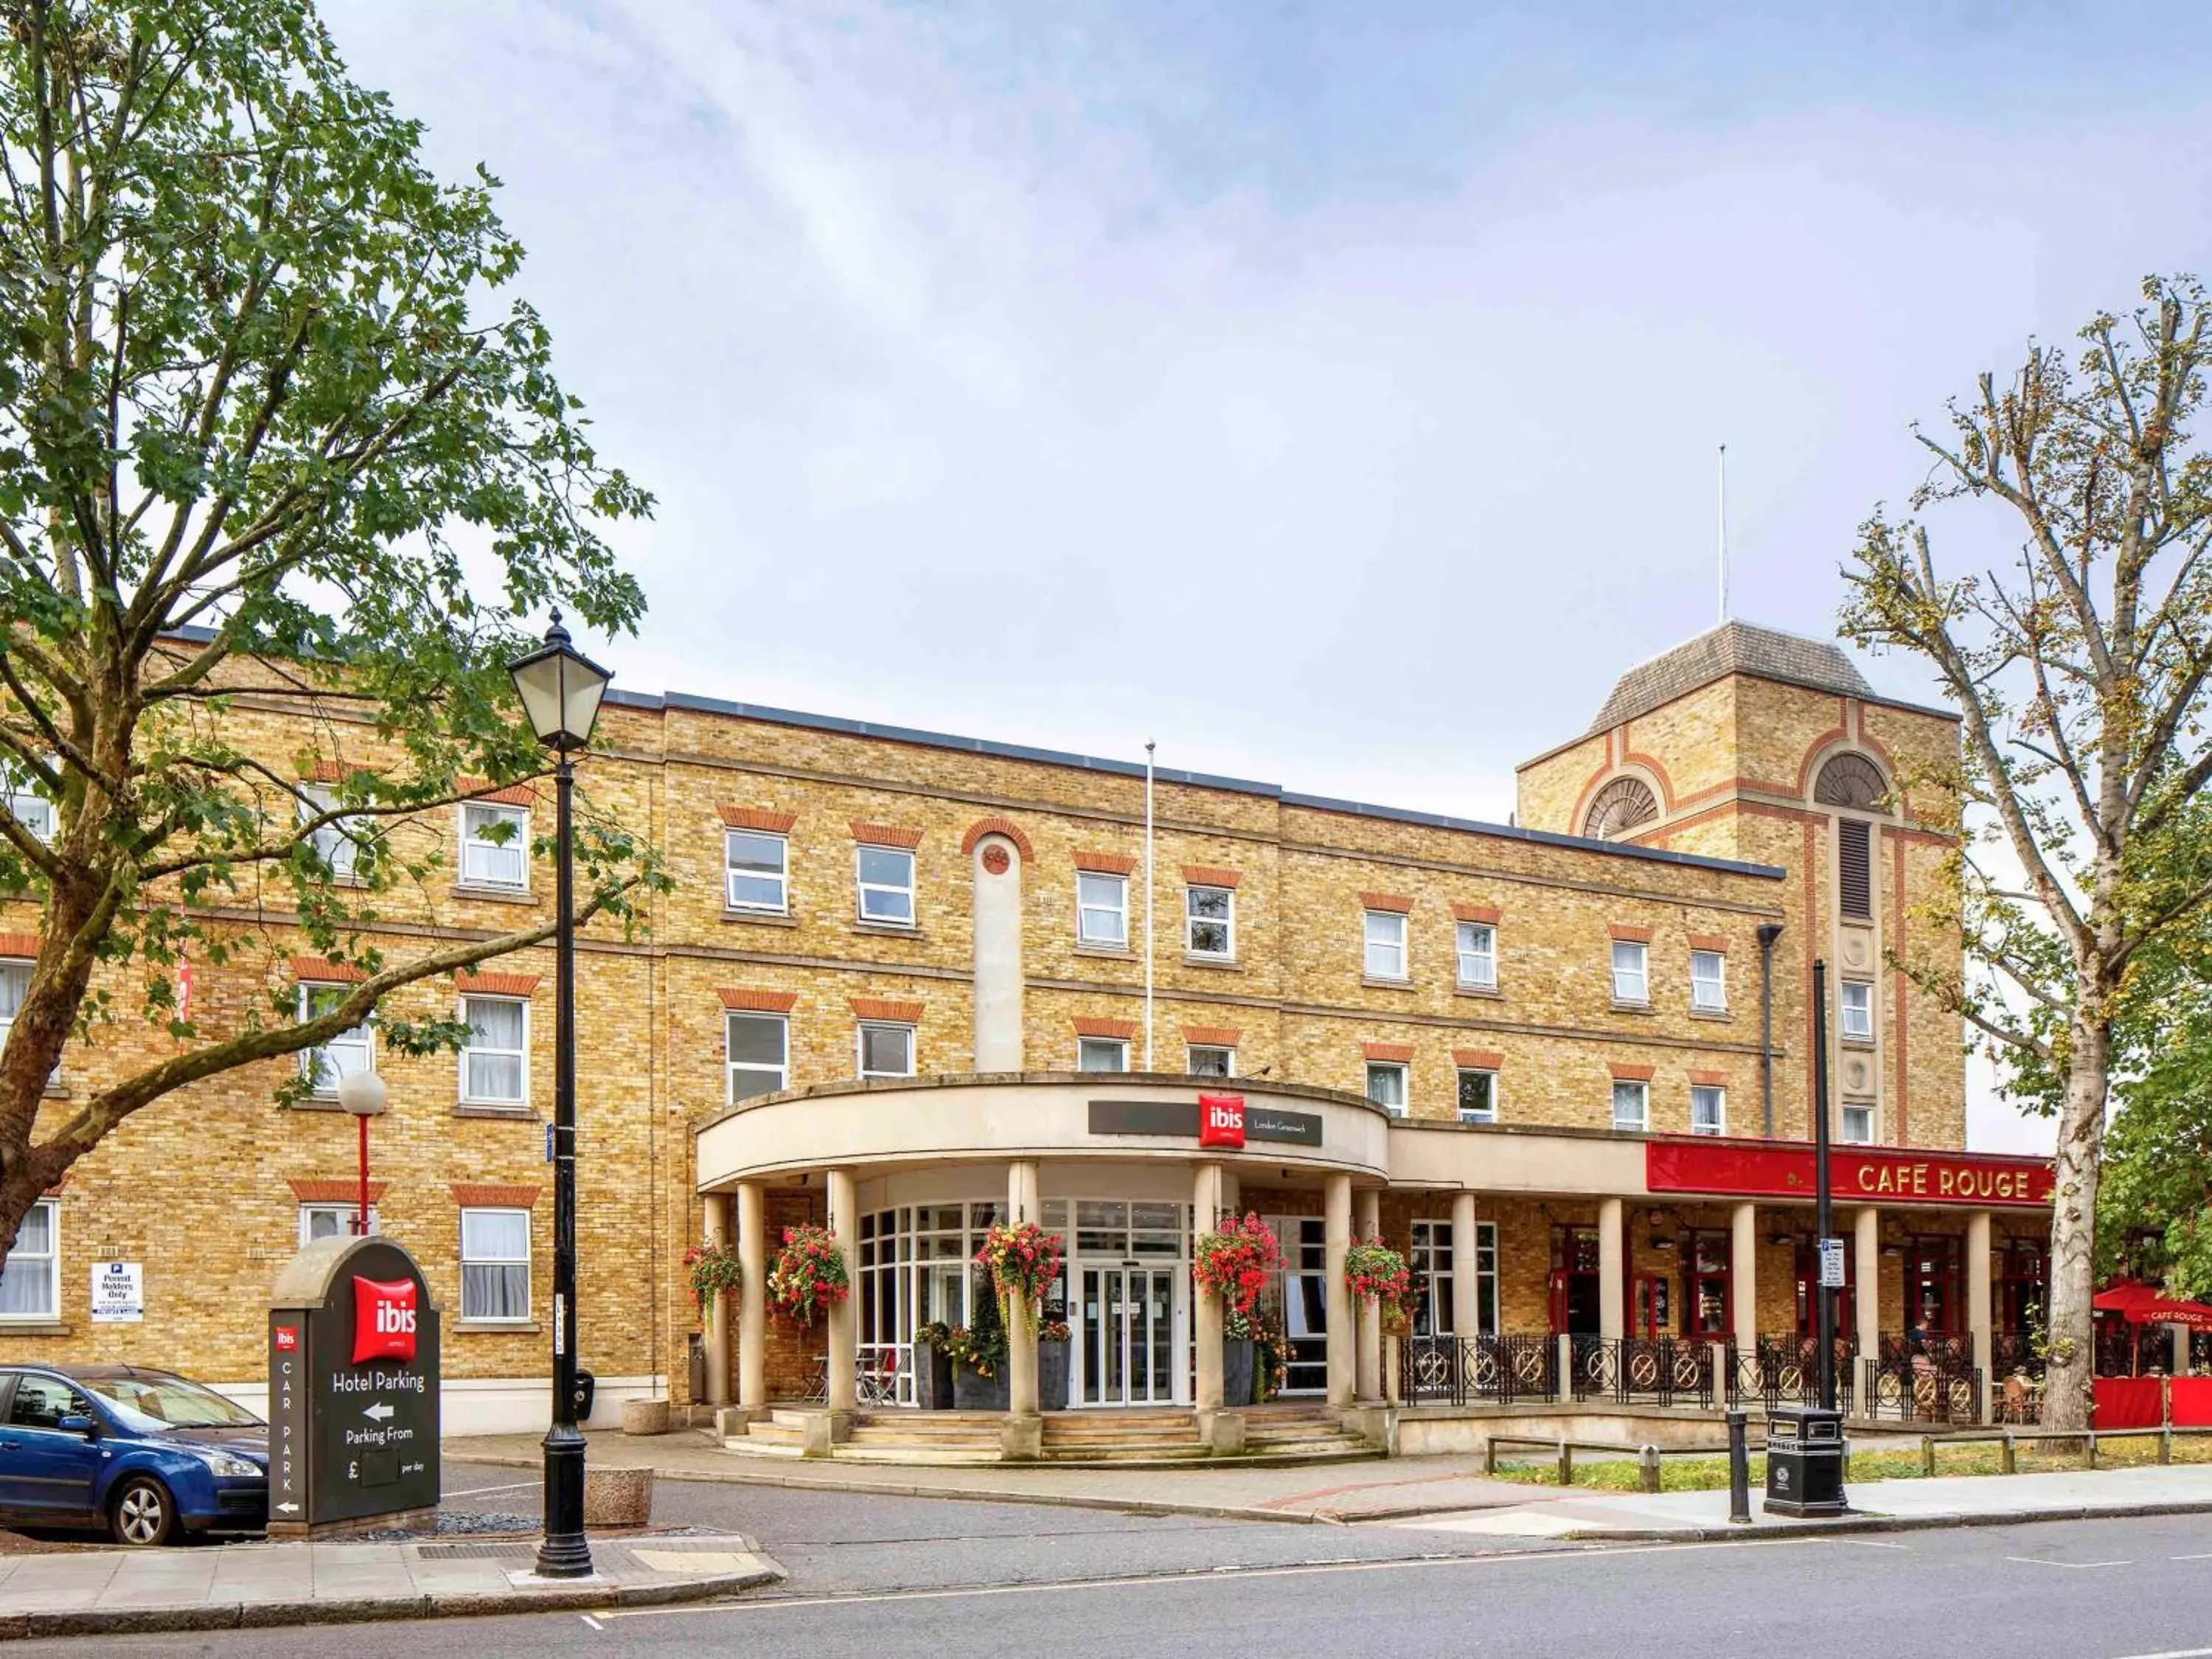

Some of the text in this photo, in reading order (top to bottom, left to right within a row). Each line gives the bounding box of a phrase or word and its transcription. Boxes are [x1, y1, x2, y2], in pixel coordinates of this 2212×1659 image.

[1210, 1107, 1243, 1129] ibis
[1858, 1164, 2028, 1198] CAFÉ ROUGE
[377, 1300, 417, 1333] ibis
[278, 1332, 294, 1344] ibis
[333, 1371, 425, 1393] Hotel Parking
[282, 1363, 291, 1490] CAR PARK
[347, 1427, 413, 1445] Parking From
[402, 1464, 413, 1473] per
[414, 1461, 424, 1472] day
